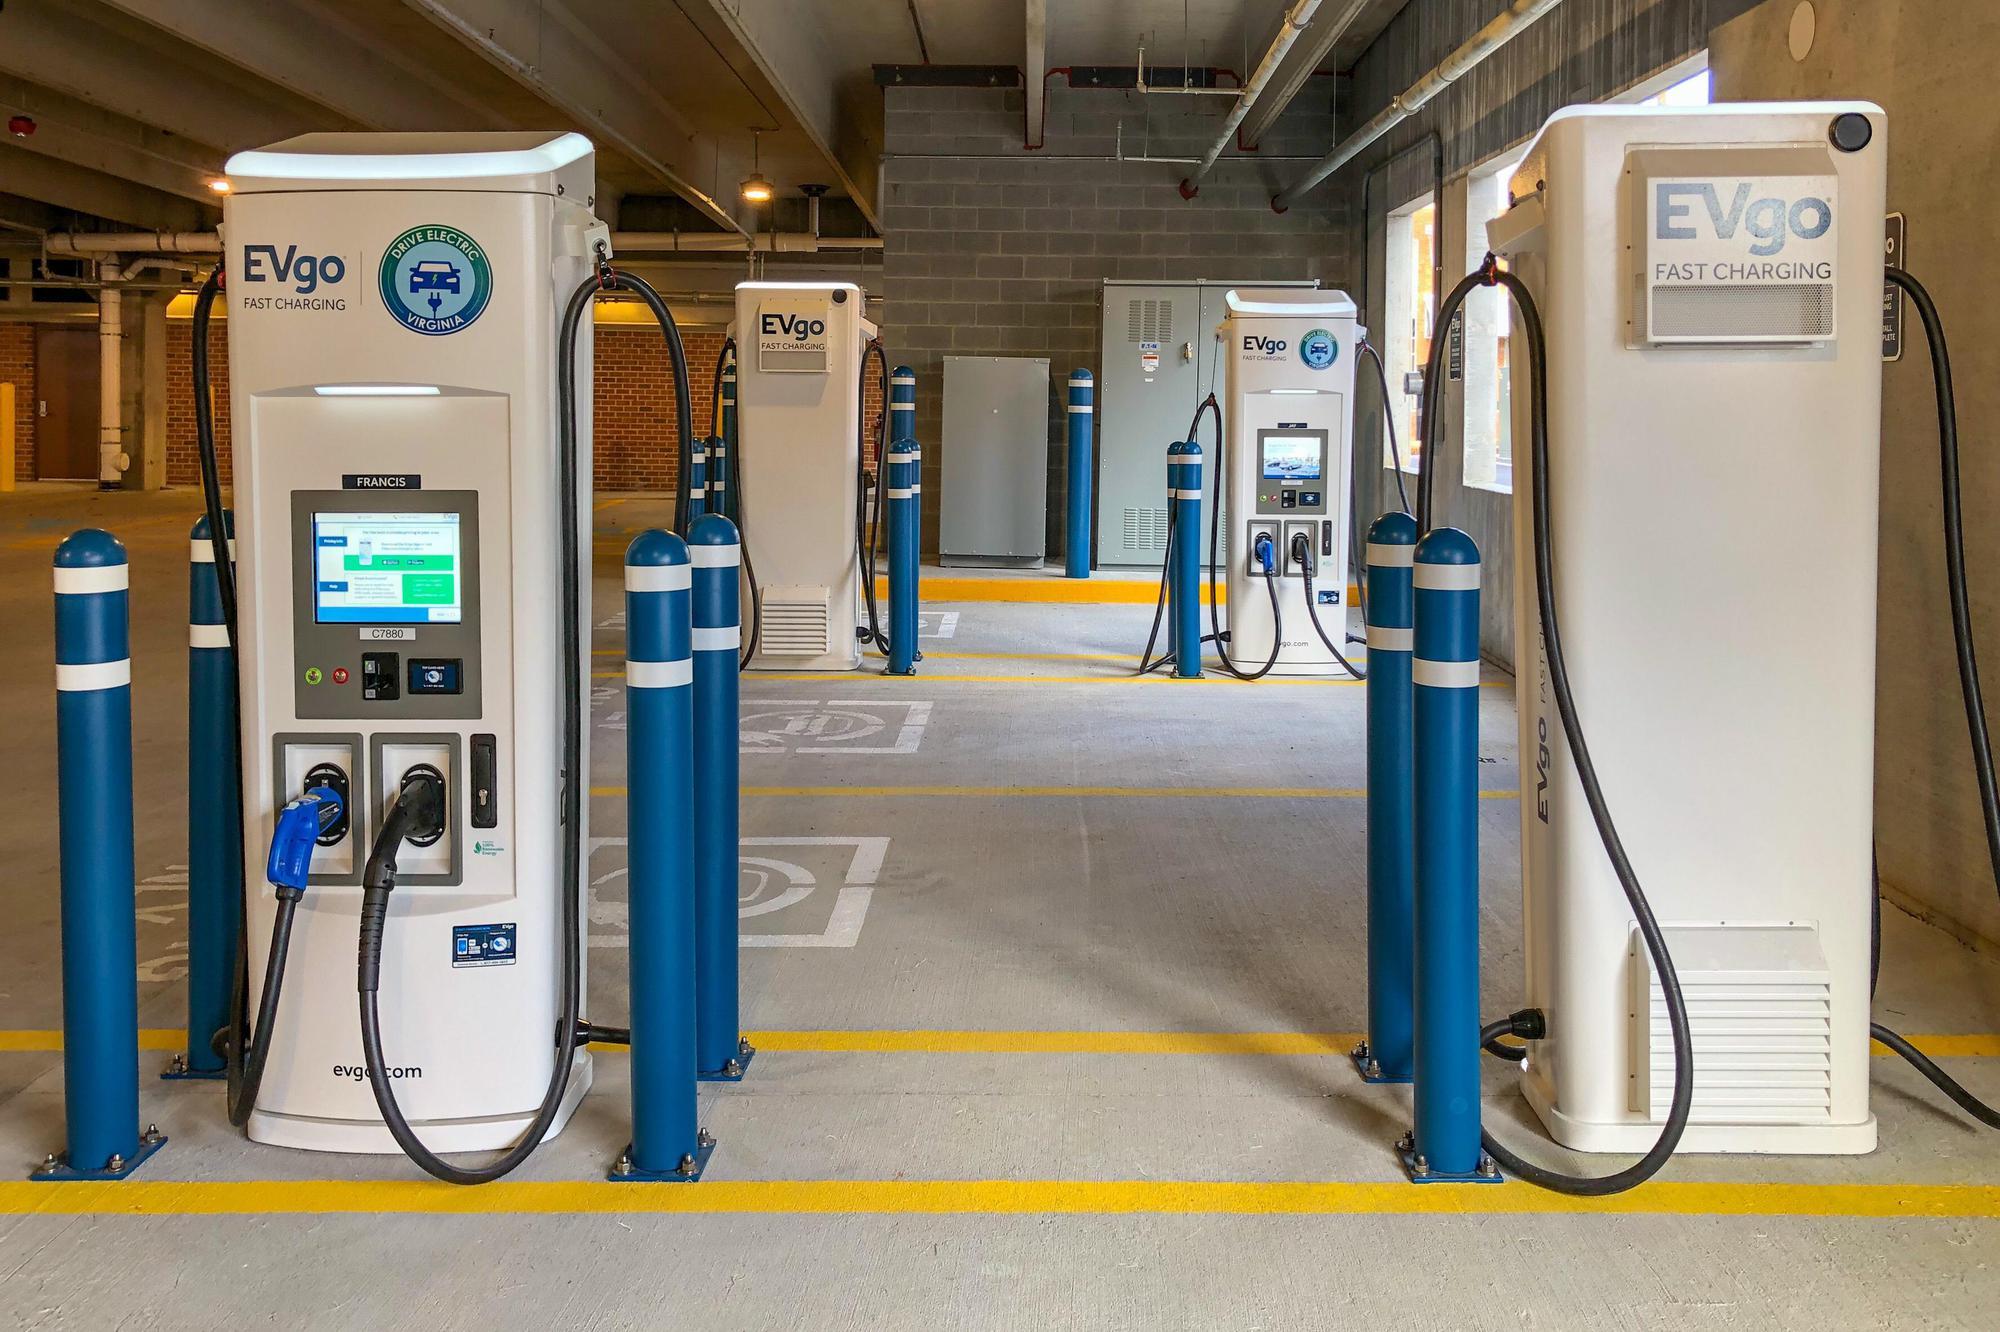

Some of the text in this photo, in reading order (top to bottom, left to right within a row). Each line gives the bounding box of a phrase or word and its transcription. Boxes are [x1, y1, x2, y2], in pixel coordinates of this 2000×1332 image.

[1656, 182, 1832, 256] EVgo
[391, 230, 480, 262] DRIVE ELECTRIC
[244, 245, 345, 294] EVgo
[1655, 262, 1831, 280] FAST CHARGING
[244, 298, 346, 311] FAST CHARGING
[406, 312, 465, 331] VIRGINIA
[762, 313, 825, 341] EVgo
[761, 342, 825, 351] FAST CHARGING
[1243, 335, 1287, 355] EVgo
[356, 477, 406, 487] FRANCIS
[371, 629, 404, 639] C7880
[1536, 716, 1550, 824] EVgo
[333, 1065, 422, 1082] evgcom
